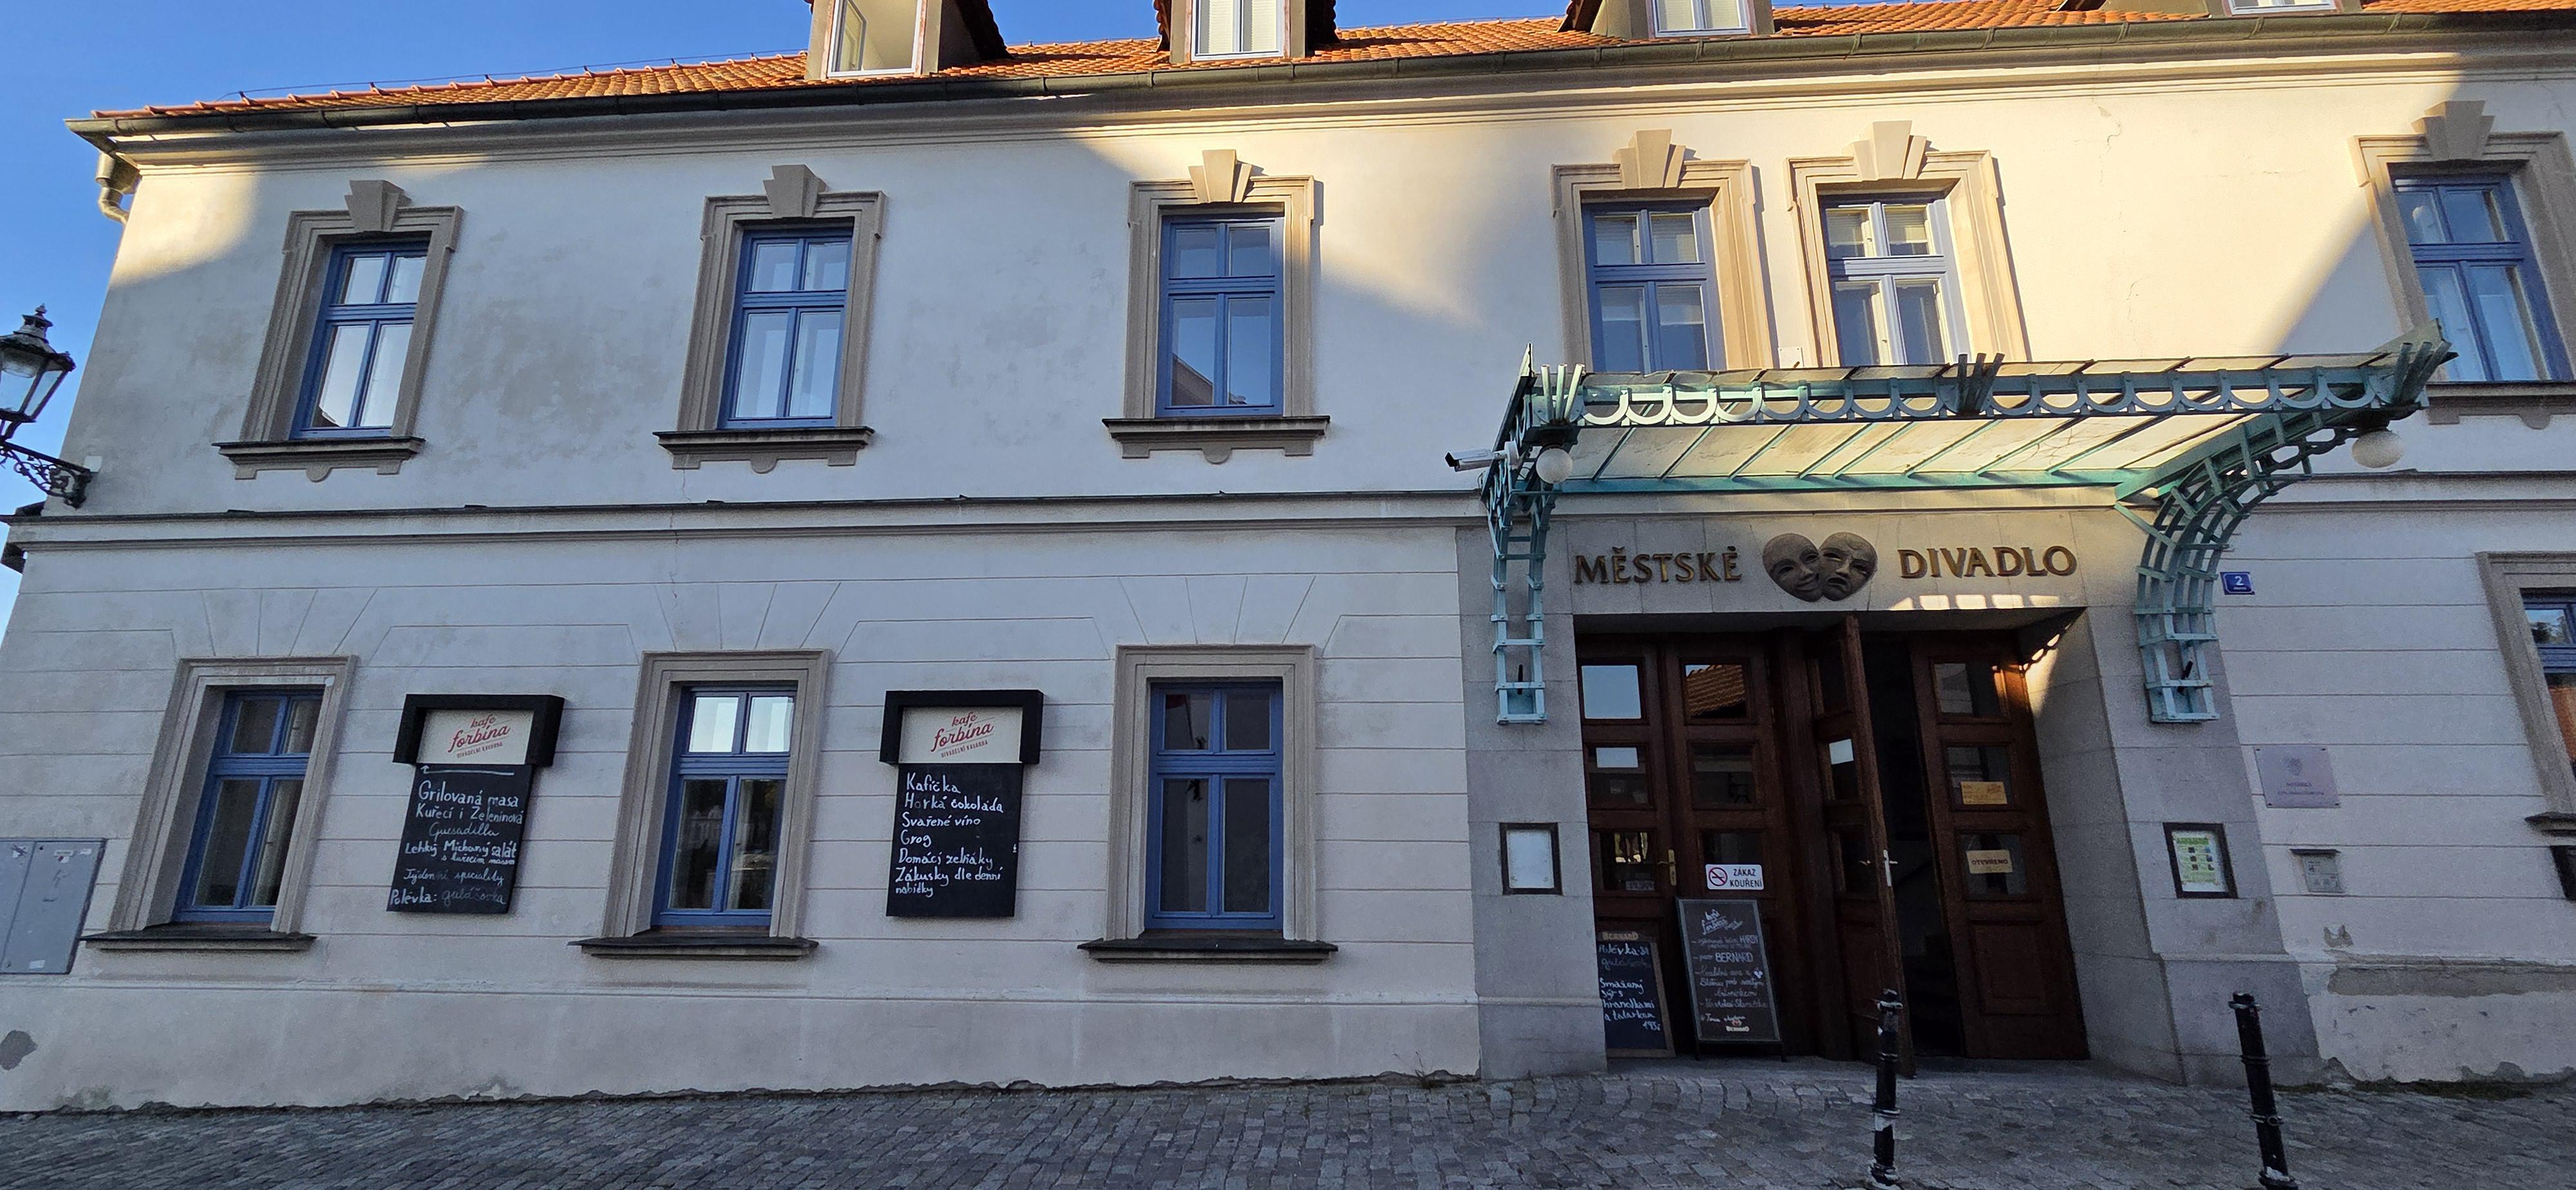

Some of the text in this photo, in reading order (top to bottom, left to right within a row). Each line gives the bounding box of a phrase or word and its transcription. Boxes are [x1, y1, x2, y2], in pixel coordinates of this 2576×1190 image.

[1897, 545, 2078, 578] DIVADLO
[2235, 576, 2244, 586] 2
[470, 713, 496, 729] kafe
[952, 712, 978, 727] kafe
[419, 780, 518, 808] Grilovaná masa
[904, 792, 948, 809] Horká
[415, 803, 524, 824] Kuřecí i Zeleninová
[902, 811, 981, 827] Svařené víno
[900, 829, 932, 847] Grog
[491, 840, 517, 858] salát
[898, 847, 942, 865] Domácí
[895, 865, 1003, 887] Zákusky dle denní
[1733, 867, 1756, 876] ZÁKAZ
[1730, 878, 1762, 887] KOUŘENÍ
[1715, 952, 1754, 963] BERNARD
